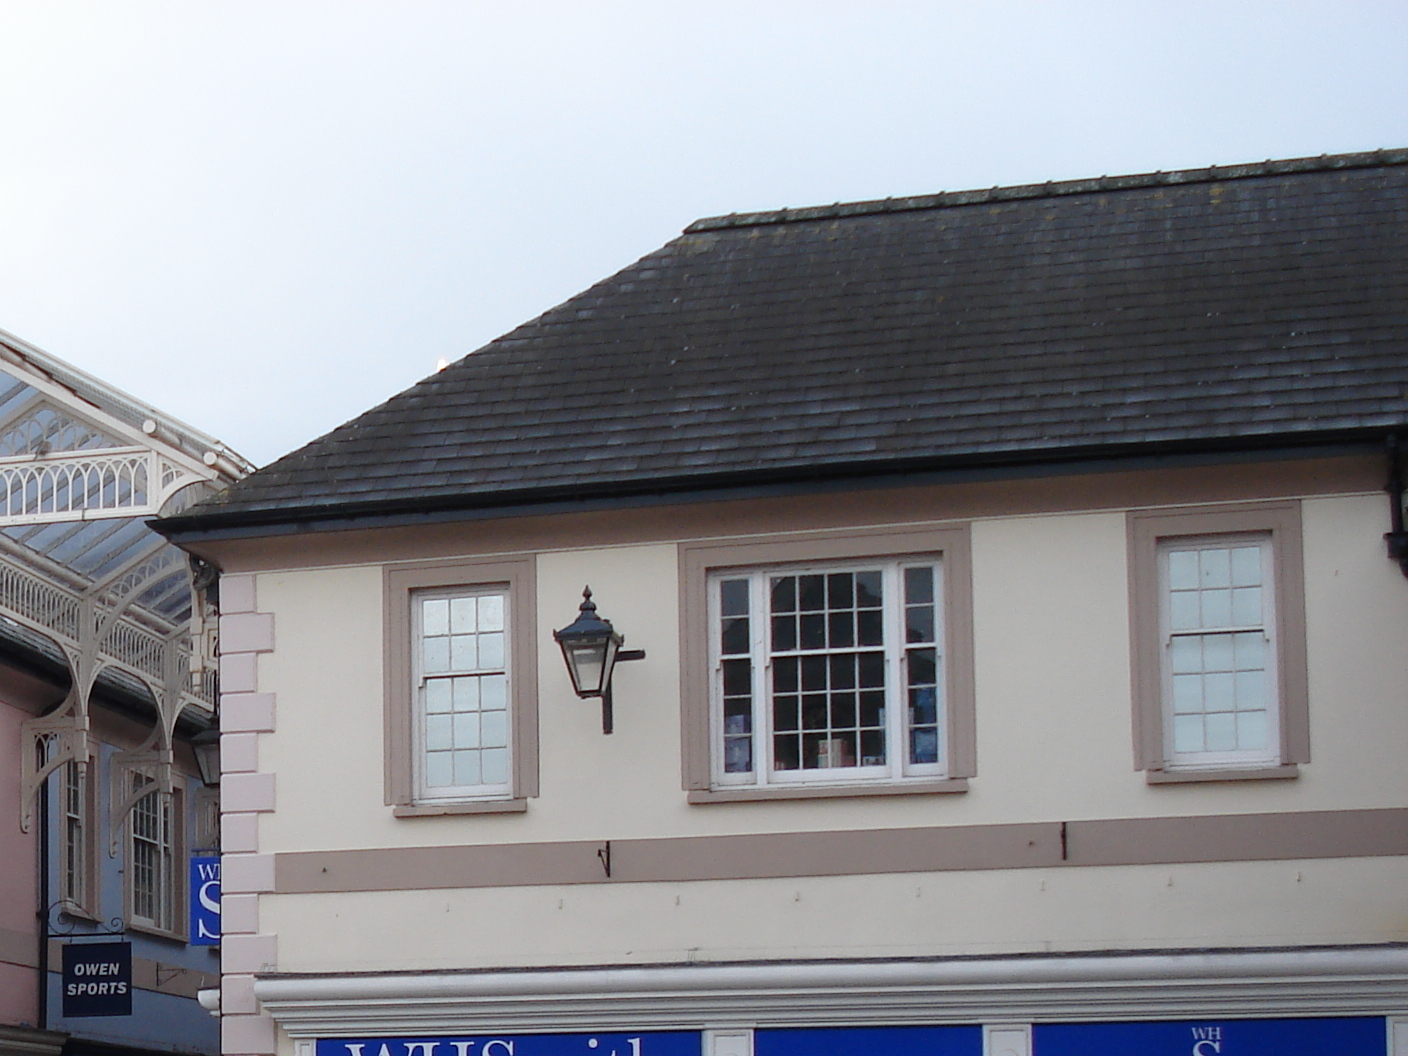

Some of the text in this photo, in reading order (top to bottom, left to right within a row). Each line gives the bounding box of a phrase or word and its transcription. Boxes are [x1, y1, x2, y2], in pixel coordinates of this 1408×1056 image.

[197, 863, 220, 880] W
[74, 963, 120, 976] OWEN
[67, 981, 128, 996] SPORTS
[1191, 1026, 1222, 1040] WH
